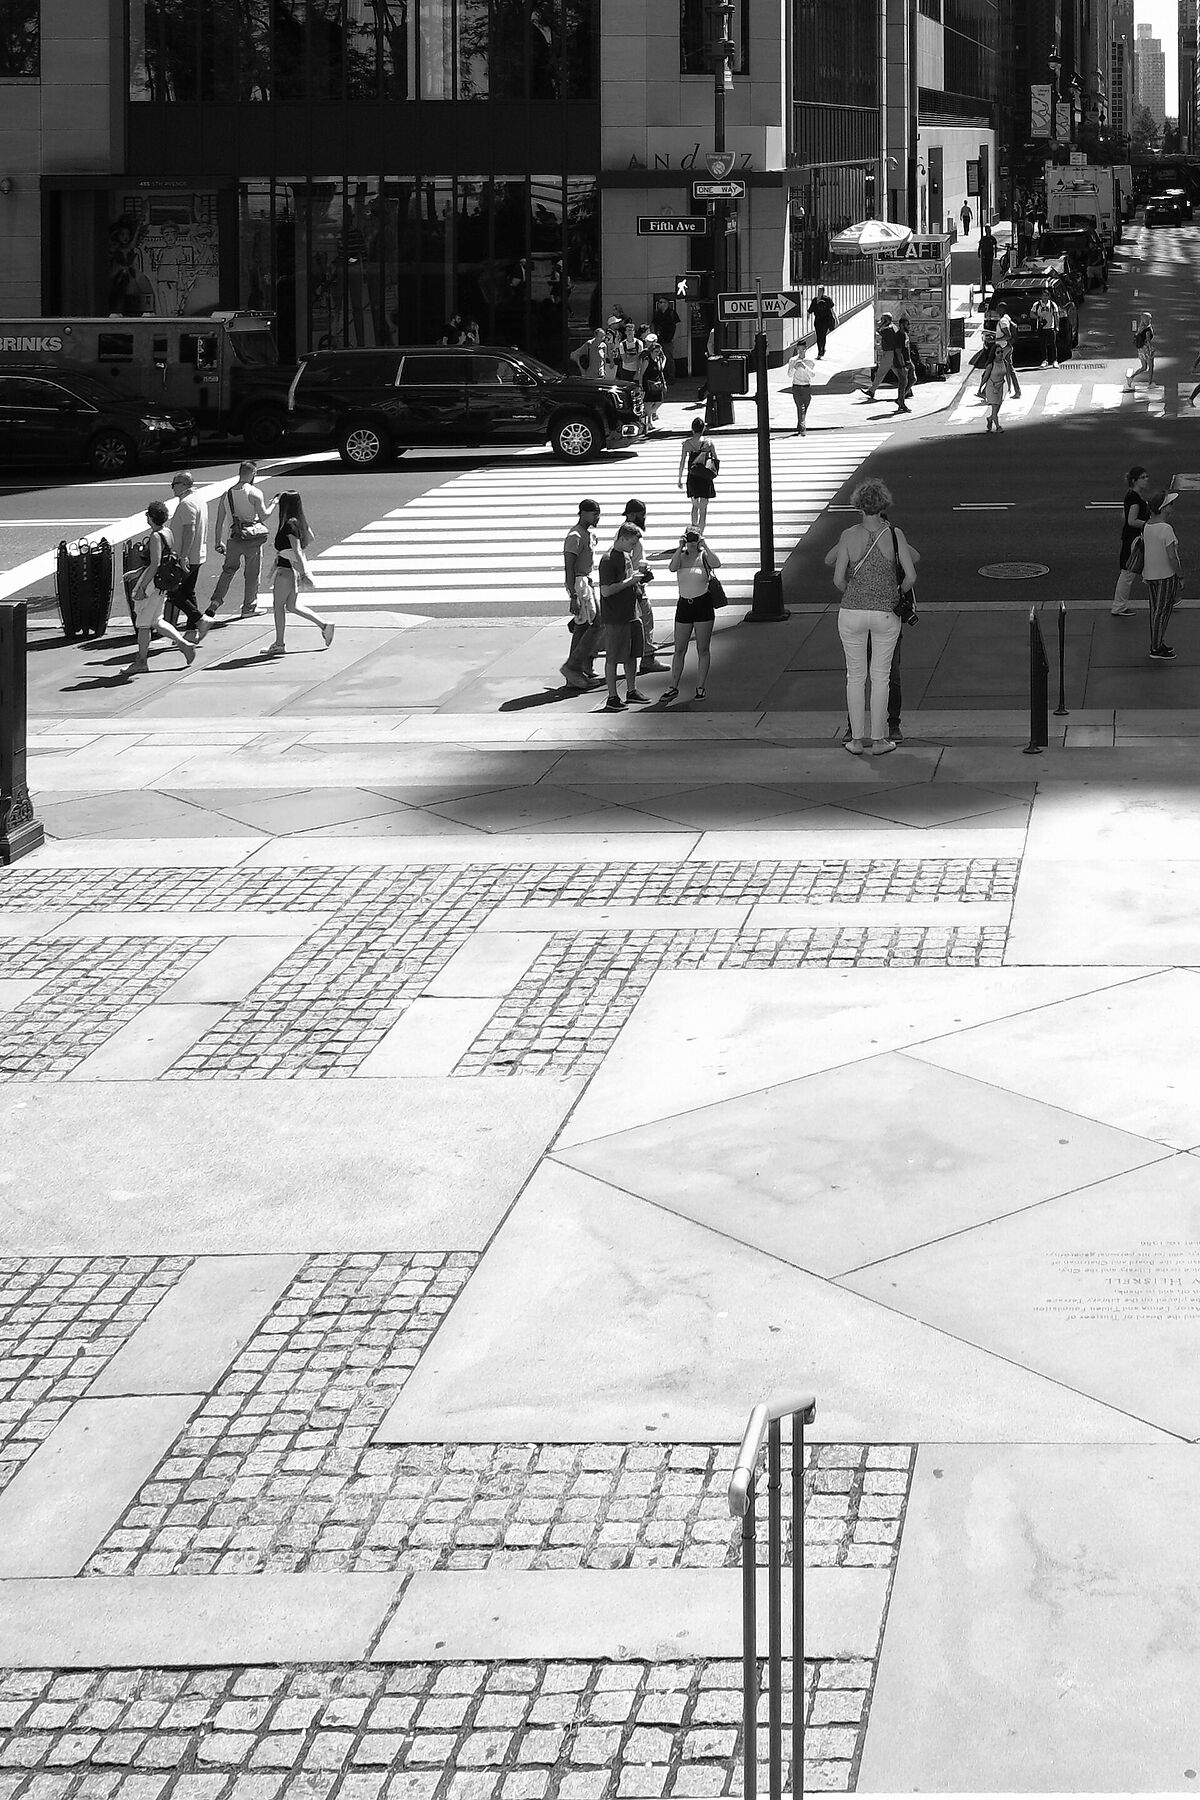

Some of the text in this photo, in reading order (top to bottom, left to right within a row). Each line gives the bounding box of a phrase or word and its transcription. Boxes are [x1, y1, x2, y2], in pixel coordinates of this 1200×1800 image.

[649, 220, 696, 231] Fifth Ave
[731, 300, 788, 312] ONE WAY
